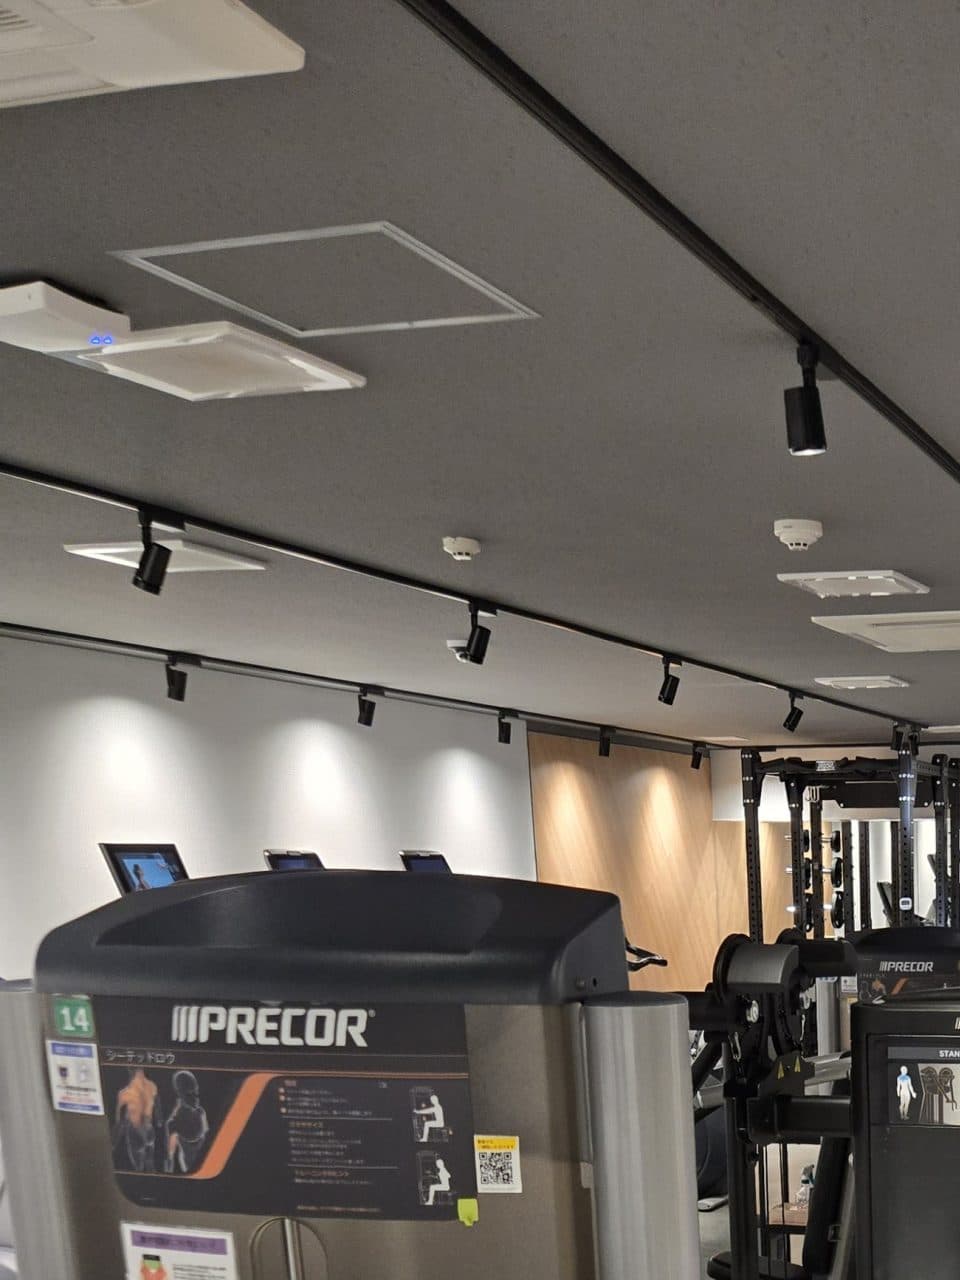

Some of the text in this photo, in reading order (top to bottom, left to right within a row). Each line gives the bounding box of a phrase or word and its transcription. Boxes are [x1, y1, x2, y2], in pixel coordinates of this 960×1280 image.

[887, 961, 934, 972] PRECOR
[60, 1006, 90, 1032] 14
[199, 1006, 368, 1047] PRECOR
